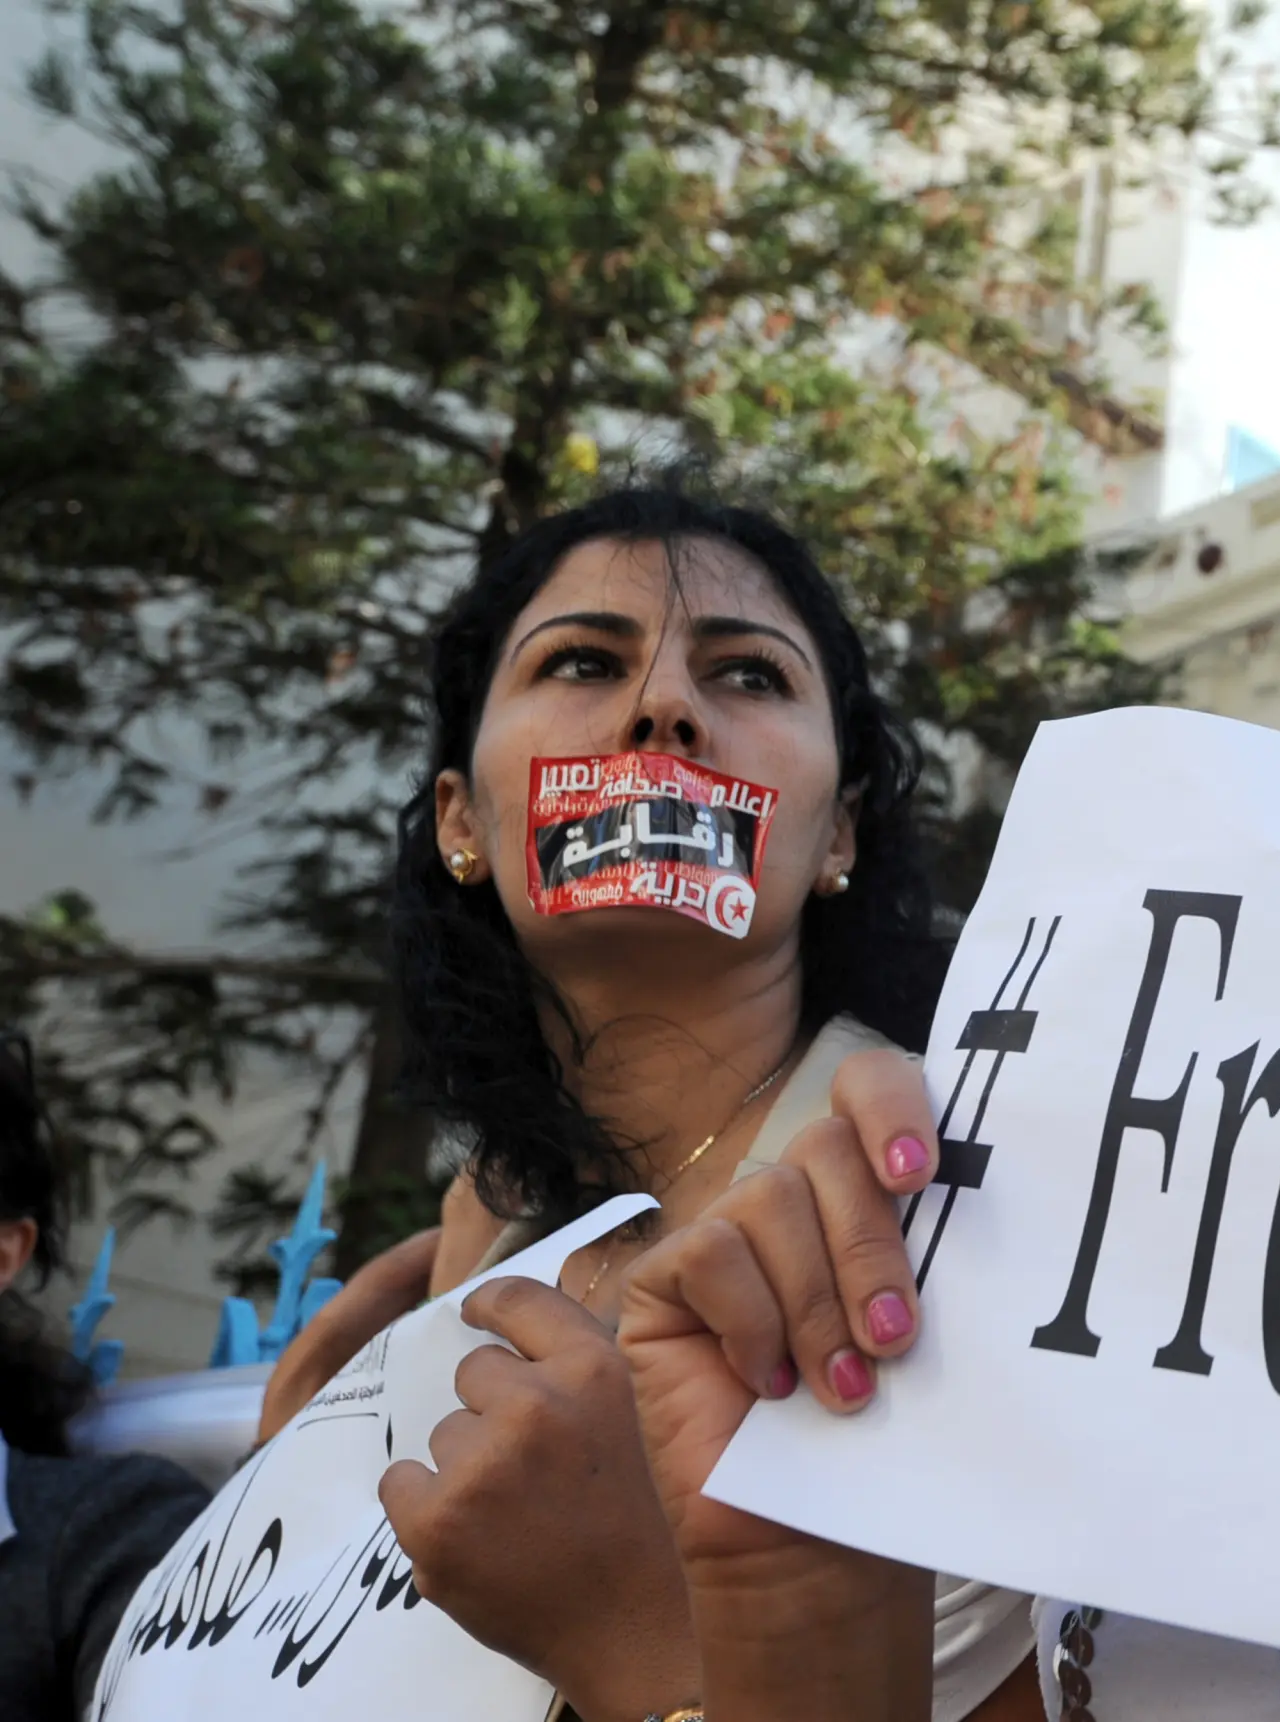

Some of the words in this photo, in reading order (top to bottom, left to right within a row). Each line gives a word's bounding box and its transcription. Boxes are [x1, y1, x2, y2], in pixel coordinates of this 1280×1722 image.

[539, 758, 601, 801] تعبير
[599, 772, 684, 800] صحافة
[562, 801, 735, 868] رقابة
[629, 861, 707, 911] حرية
